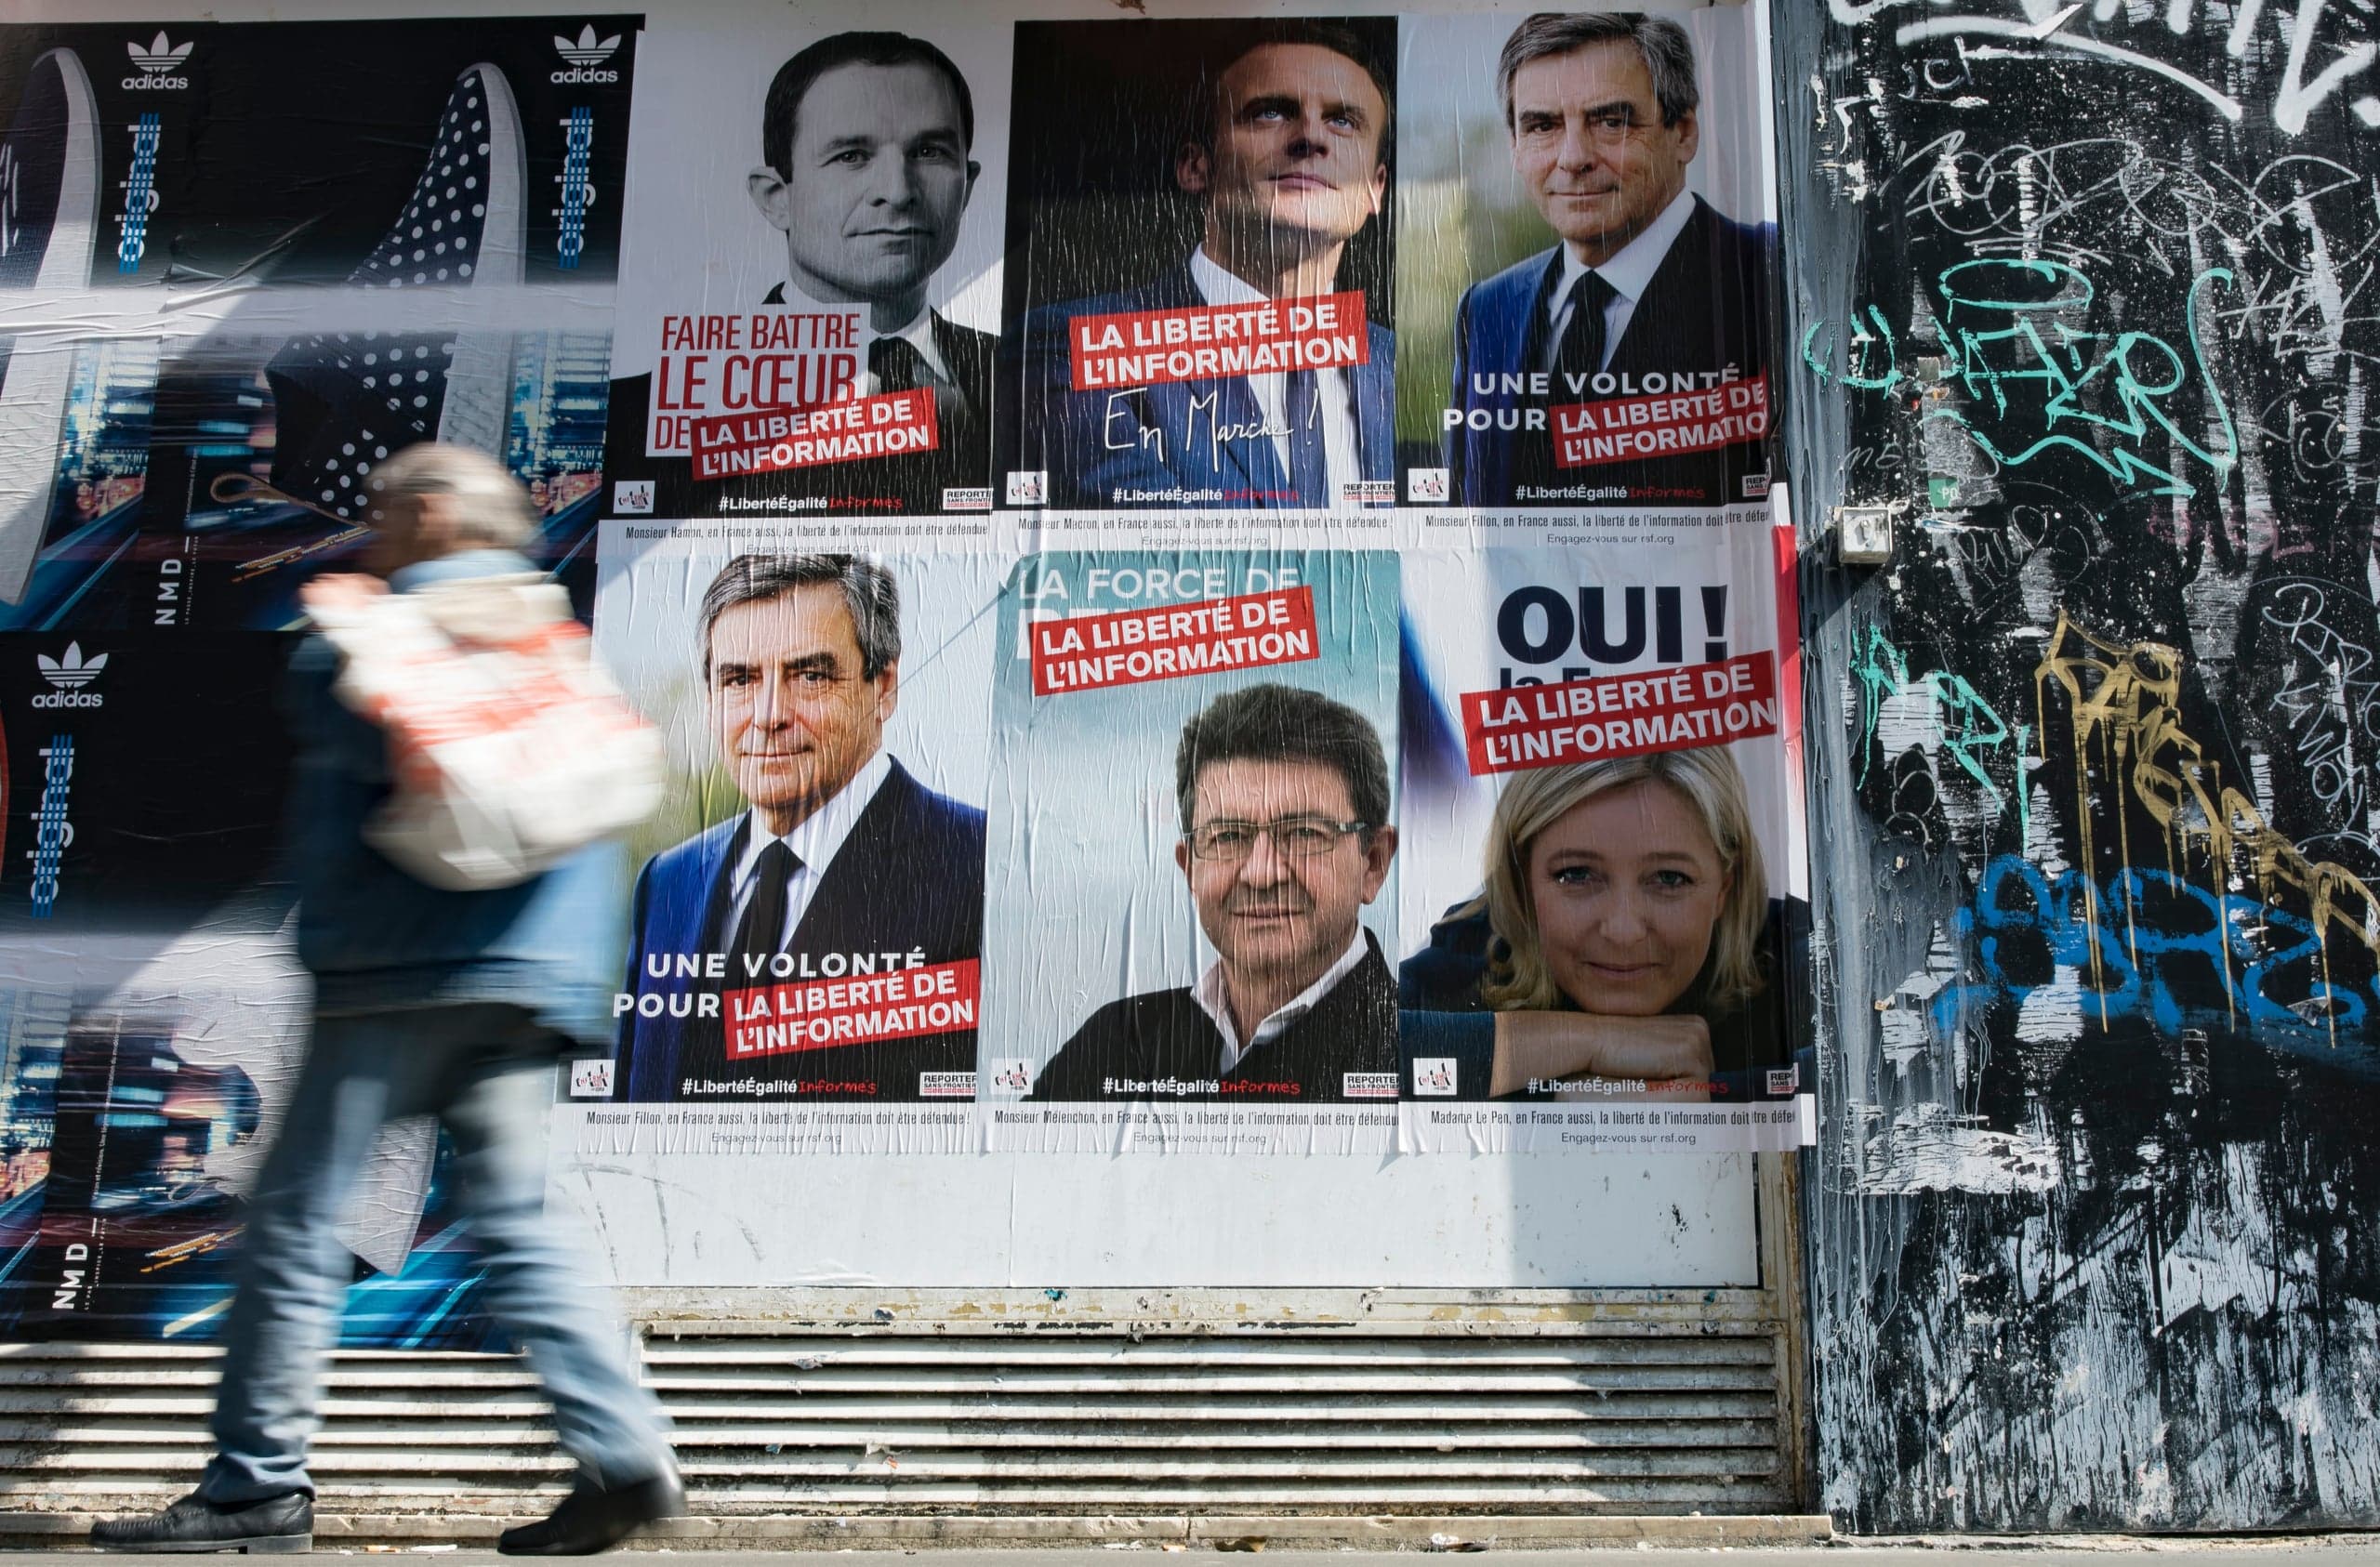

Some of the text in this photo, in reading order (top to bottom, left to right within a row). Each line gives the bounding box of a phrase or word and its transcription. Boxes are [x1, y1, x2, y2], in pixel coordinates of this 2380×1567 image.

[122, 74, 189, 90] adidas
[551, 68, 618, 84] adidas
[661, 313, 861, 351] FAIRE BATTRE
[1080, 304, 1338, 352] LA LIBERTÉ DE
[1084, 335, 1356, 386] L'INFORMATION
[657, 354, 857, 411] LE CŒUR
[1474, 362, 1740, 395] UNE VOLONTÉ
[699, 399, 913, 448] LA LIBERTÉ DE
[1444, 408, 1547, 431] POUR
[1560, 380, 1765, 434] LA LIBERTÉ DE
[654, 415, 691, 450] DE
[1104, 388, 1165, 463] En
[1185, 388, 1294, 473] Marche
[702, 425, 929, 477] L'INFORMATION
[626, 526, 668, 539] Monsieur
[671, 527, 704, 540] Hamon,
[707, 528, 719, 538] en
[722, 526, 751, 538] France
[785, 526, 793, 537] la
[797, 525, 826, 537] liberté
[830, 526, 840, 536] de
[844, 524, 901, 536] l'information
[905, 524, 922, 536] doit
[925, 524, 943, 535] être
[946, 523, 988, 535] défendue
[1018, 518, 1060, 530] Monsieur
[1104, 520, 1115, 530] en
[1117, 518, 1148, 529] France
[1152, 518, 1178, 530] aussi,
[1182, 518, 1191, 529] la
[1194, 517, 1223, 529] liberté
[1227, 517, 1238, 528] de
[1241, 517, 1300, 529] l'information
[1346, 516, 1387, 528] défendue
[1425, 515, 1468, 527] Monsieur
[1472, 515, 1500, 529] Fillon,
[1503, 517, 1514, 527] en
[1518, 515, 1548, 527] France
[1552, 515, 1579, 528] aussi,
[1582, 515, 1592, 527] la
[1595, 514, 1625, 527] liberté
[1629, 515, 1640, 527] de
[1644, 514, 1702, 527] l'information
[1706, 514, 1724, 527] doit
[1547, 534, 1619, 545] Engagez-vous
[1641, 534, 1674, 545] rsf.org
[154, 558, 181, 625] NMD
[1019, 567, 1298, 599] LA FORCE DE
[1042, 629, 1083, 655] LA
[1092, 601, 1233, 648] LIBERTÉ
[1242, 598, 1290, 626] DE
[1497, 583, 1729, 665] OUI !
[1046, 629, 1311, 690] L'INFORMATION
[32, 690, 103, 708] adidas
[1479, 697, 1528, 729] LA
[1536, 668, 1695, 720] LIBERTÉ
[1702, 664, 1754, 700] DE
[1485, 696, 1777, 765] L'INFORMATION
[647, 946, 926, 979] UNE VOLONTÉ
[613, 993, 719, 1019] POUR
[734, 970, 956, 1022] LA LIBERTÉ DE
[736, 998, 974, 1053] L'INFORMATION
[587, 1111, 630, 1125] Monsieur
[635, 1111, 663, 1126] Fillon,
[667, 1113, 679, 1125] en
[682, 1112, 714, 1124] France
[718, 1112, 746, 1126] aussi,
[749, 1112, 758, 1125] la
[797, 1112, 807, 1125] de
[812, 1111, 872, 1125] l'information
[876, 1111, 894, 1125] doit
[920, 1111, 964, 1125] défendue
[994, 1110, 1038, 1124] Monsieur
[1043, 1110, 1098, 1125] Mélenchon,
[1102, 1113, 1113, 1124] en
[1117, 1111, 1148, 1124] France
[1184, 1111, 1193, 1125] la
[1197, 1111, 1228, 1125] liberté
[1233, 1112, 1244, 1125] de
[1248, 1112, 1309, 1126] l'information
[1313, 1112, 1331, 1126] doit
[1431, 1111, 1473, 1125] Madame
[1476, 1111, 1488, 1125] Le
[1491, 1111, 1512, 1126] Pen,
[1515, 1113, 1527, 1125] en
[1531, 1111, 1564, 1125] France
[1567, 1111, 1596, 1126] aussi,
[1600, 1111, 1608, 1125] la
[1613, 1111, 1645, 1125] liberté
[1649, 1111, 1660, 1125] de
[1664, 1111, 1726, 1125] l'information
[1730, 1111, 1750, 1126] doit
[788, 1135, 804, 1143] sur
[1561, 1132, 1697, 1144] Engagez-vous sur rsf.org
[52, 1243, 88, 1310] NMD
